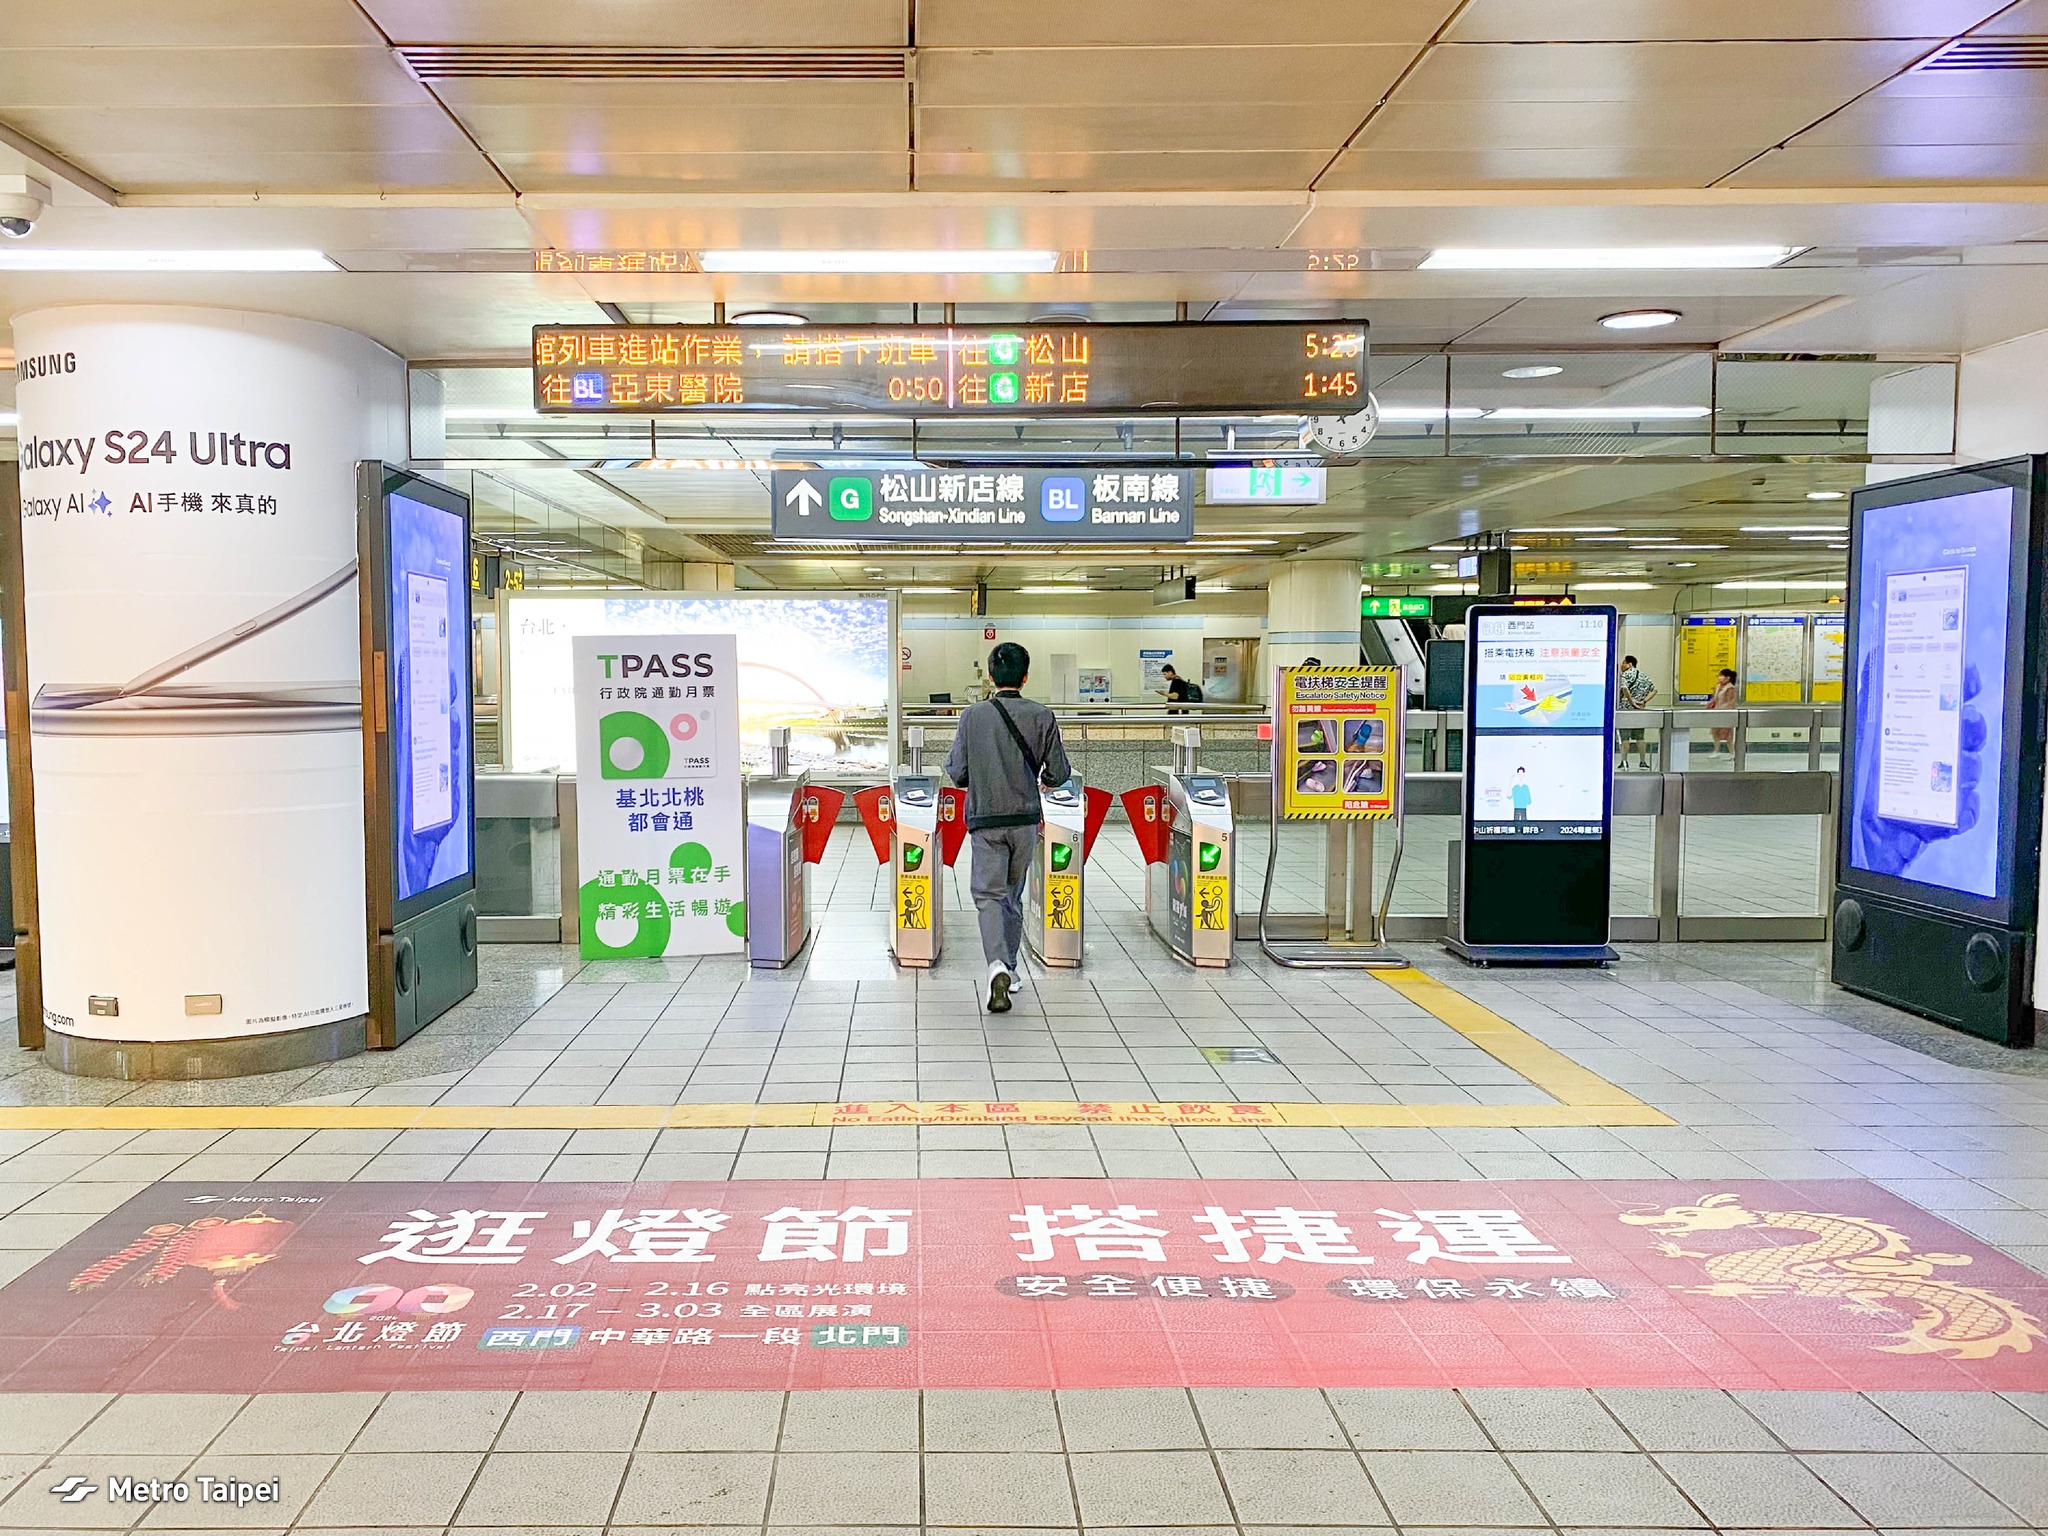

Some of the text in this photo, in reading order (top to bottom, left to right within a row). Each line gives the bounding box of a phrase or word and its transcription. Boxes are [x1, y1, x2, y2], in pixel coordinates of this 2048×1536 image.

[958, 334, 987, 366] 往
[1026, 334, 1089, 365] 松山
[1304, 332, 1358, 360] 5:25
[16, 352, 76, 383] MSUNG
[541, 374, 943, 405] 往 BL 亞東醫院 0:50
[958, 373, 987, 404] 往
[1025, 372, 1089, 403] 新店
[1304, 371, 1358, 397] 1:45
[104, 430, 177, 464] S24
[189, 431, 292, 470] Ultra
[839, 489, 861, 510] G
[879, 474, 1025, 504] 松山新店線
[1091, 474, 1181, 504] 板南線
[66, 493, 84, 514] AI
[211, 492, 277, 516] 來真的
[1048, 489, 1080, 511] BL
[878, 507, 1026, 528] Songshan-Xindian Line
[1091, 508, 1180, 524] Bannan Line
[1579, 619, 1603, 629] 11:10
[597, 653, 714, 679] TPASS
[600, 685, 715, 699] 行政院通勤月票
[1294, 676, 1387, 689] 電扶梯安全提醒
[1295, 691, 1386, 701] Escalator Safety Notice
[616, 787, 704, 808] 基北北桃
[628, 812, 694, 832] 都會通
[1072, 834, 1079, 842] 6
[1221, 833, 1228, 841] 5
[598, 865, 731, 888] 通勤月票在手
[598, 898, 732, 921] 精彩生活暢遊
[834, 1102, 1266, 1114] 進入本區 禁止飲食
[867, 1115, 1027, 1123] Eating/Drinking
[1034, 1115, 1112, 1123] Beyond
[356, 1205, 1573, 1265] 逛燈節 搭捷運
[512, 1282, 598, 1297] 2.02
[643, 1281, 730, 1296] 2.16
[744, 1283, 908, 1296] 點亮光環境
[1016, 1274, 1616, 1299] 安全便捷 環保永續
[498, 1303, 589, 1319] 2.17
[635, 1302, 723, 1318] 3.03
[739, 1304, 872, 1317] 全區展演
[281, 1322, 467, 1345] 台北燈節
[486, 1327, 901, 1346] 西門 中華路一段 北門
